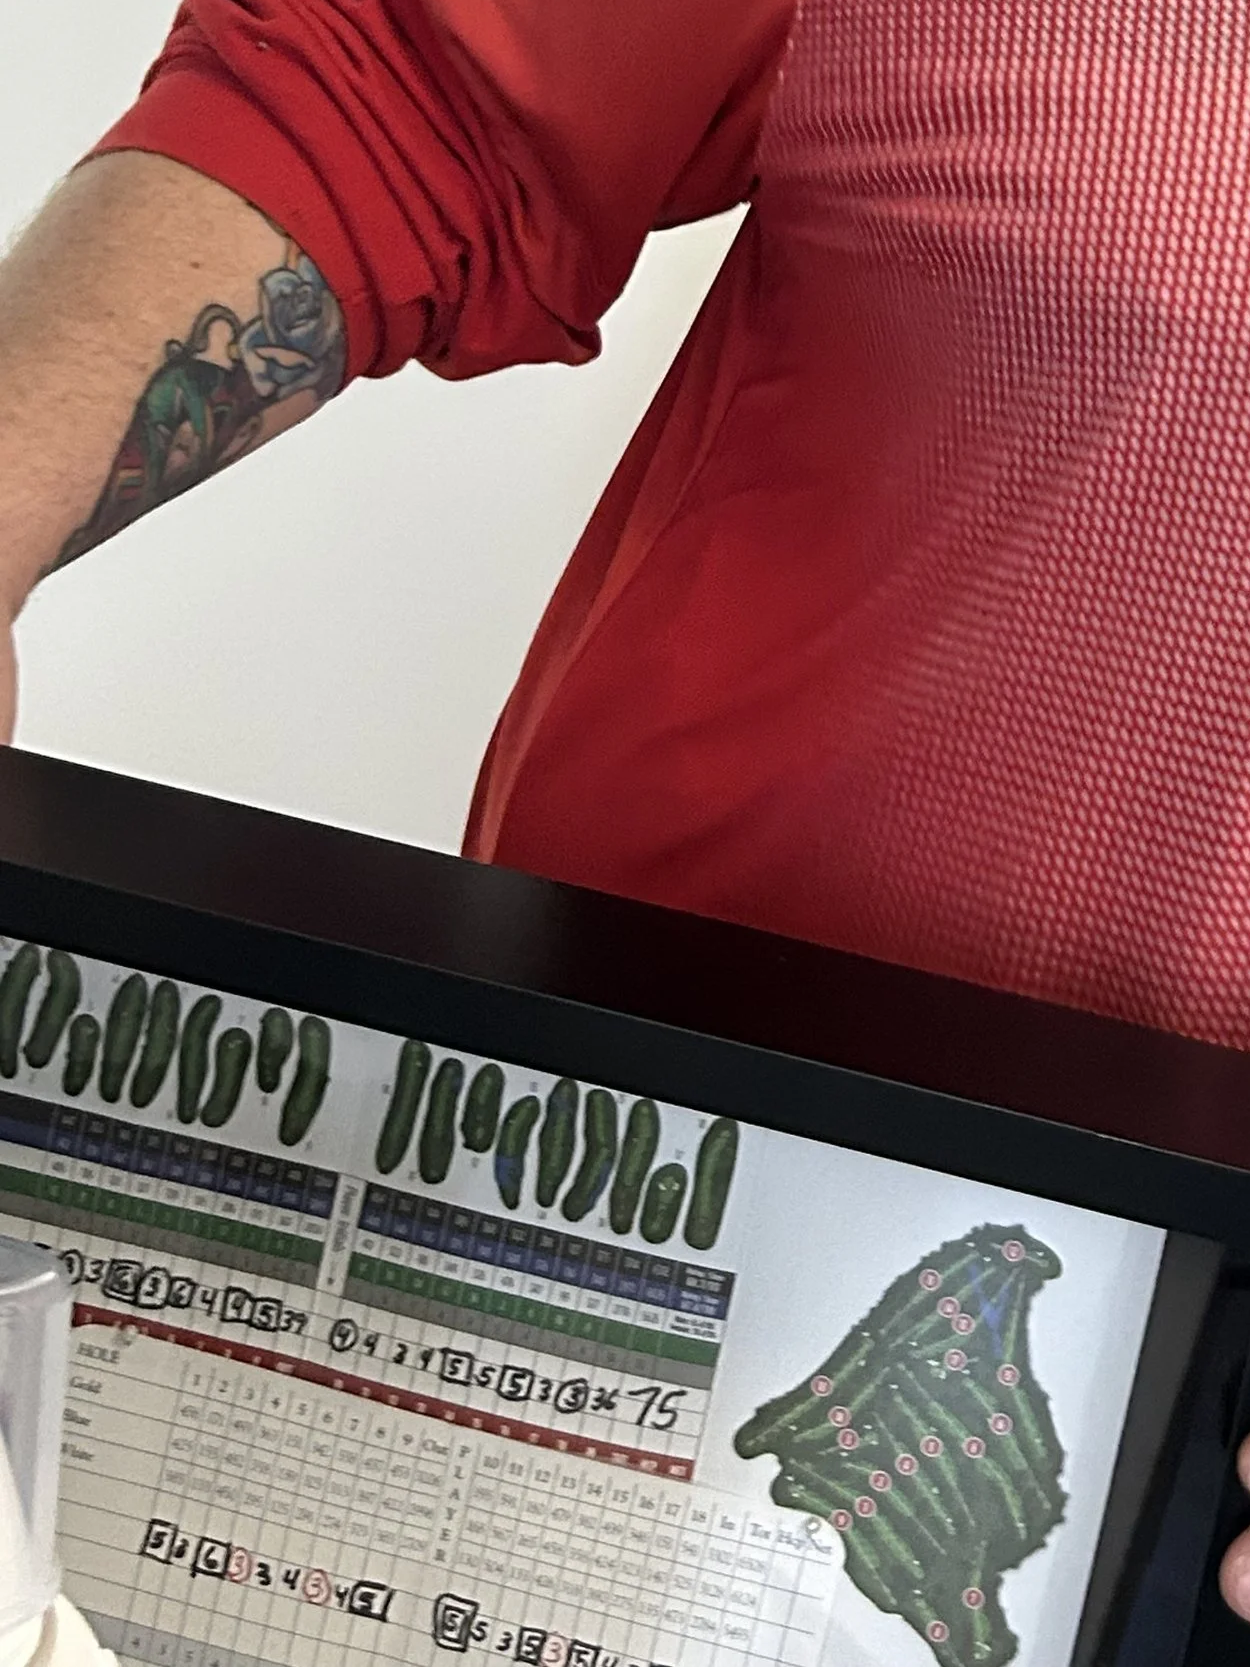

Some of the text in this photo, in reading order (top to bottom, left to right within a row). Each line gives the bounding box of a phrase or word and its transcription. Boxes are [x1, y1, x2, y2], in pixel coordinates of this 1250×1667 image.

[590, 1387, 618, 1411] 36
[628, 1386, 687, 1430] 75
[534, 1468, 552, 1483] 12
[611, 1488, 630, 1504] 15
[255, 1562, 271, 1586] 3
[282, 1568, 301, 1591] 4
